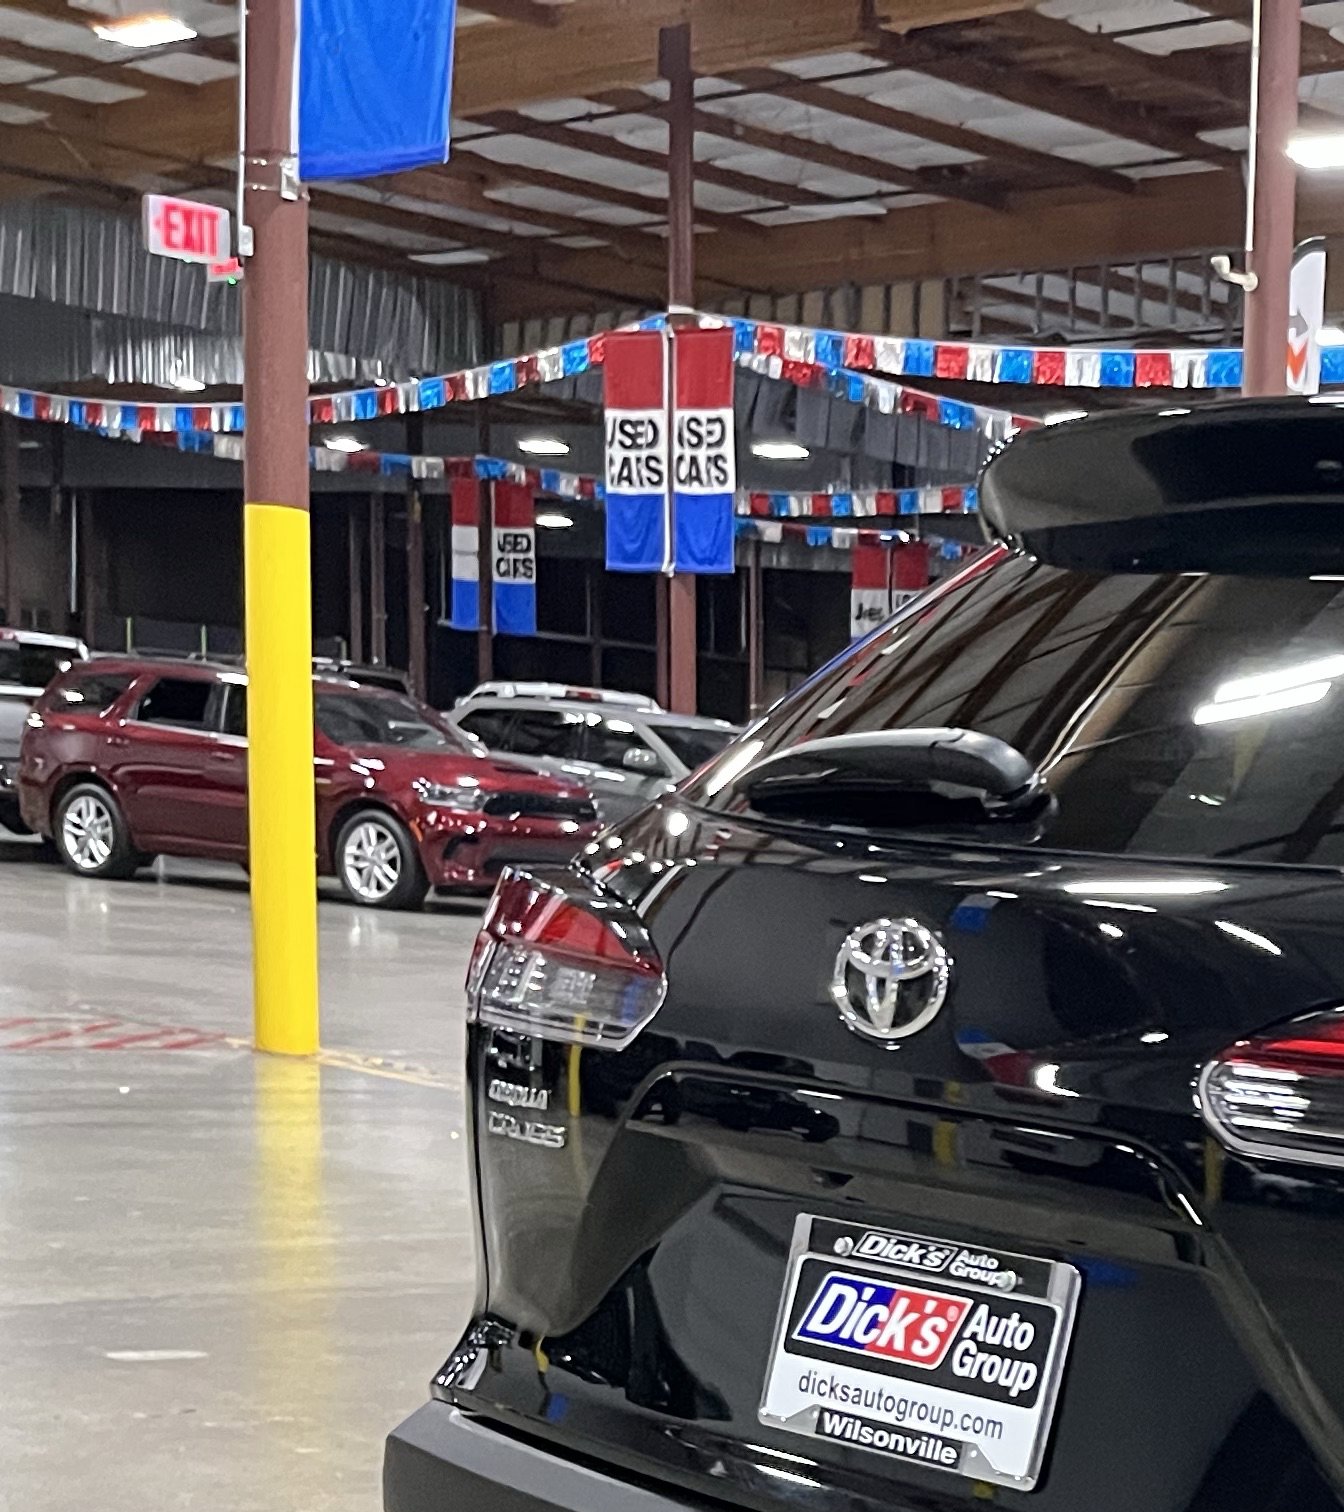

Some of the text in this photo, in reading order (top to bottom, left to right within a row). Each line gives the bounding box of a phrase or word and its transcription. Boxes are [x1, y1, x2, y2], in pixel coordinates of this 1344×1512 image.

[163, 203, 219, 257] EXIT
[955, 1249, 999, 1270] Auto
[806, 1282, 1035, 1358] Dick's Auto
[951, 1340, 1039, 1397] Group
[797, 1370, 1005, 1441] dicksautogroup.com
[822, 1410, 959, 1465] Wilsonville
